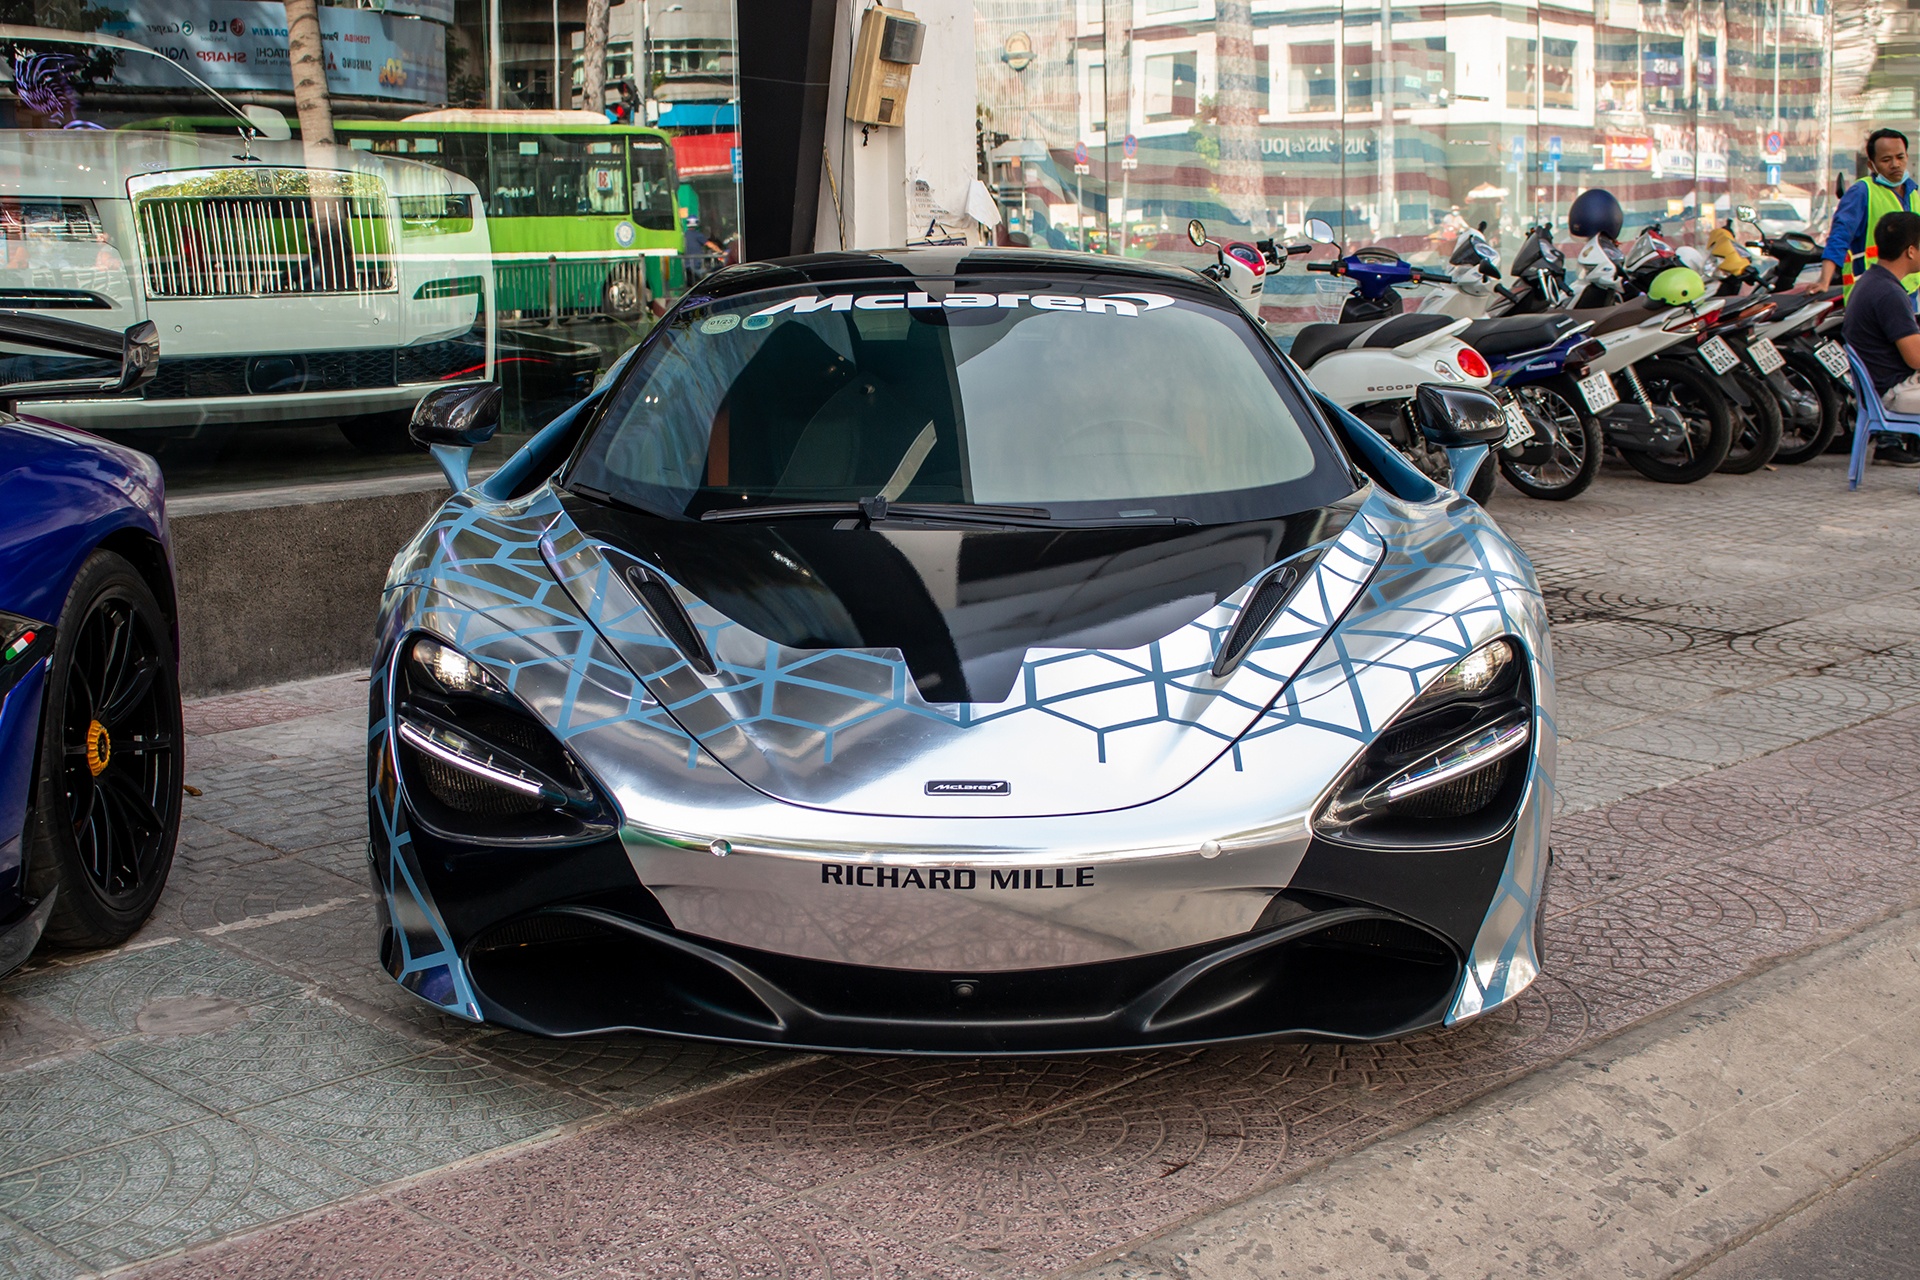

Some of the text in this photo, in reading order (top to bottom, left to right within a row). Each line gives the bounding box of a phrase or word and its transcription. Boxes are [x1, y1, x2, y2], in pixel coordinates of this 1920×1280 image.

[750, 291, 1175, 318] McLaren
[1367, 384, 1417, 392] SCOOP
[932, 782, 1005, 791] McLaren
[821, 863, 1095, 890] RICHARD MILLE
